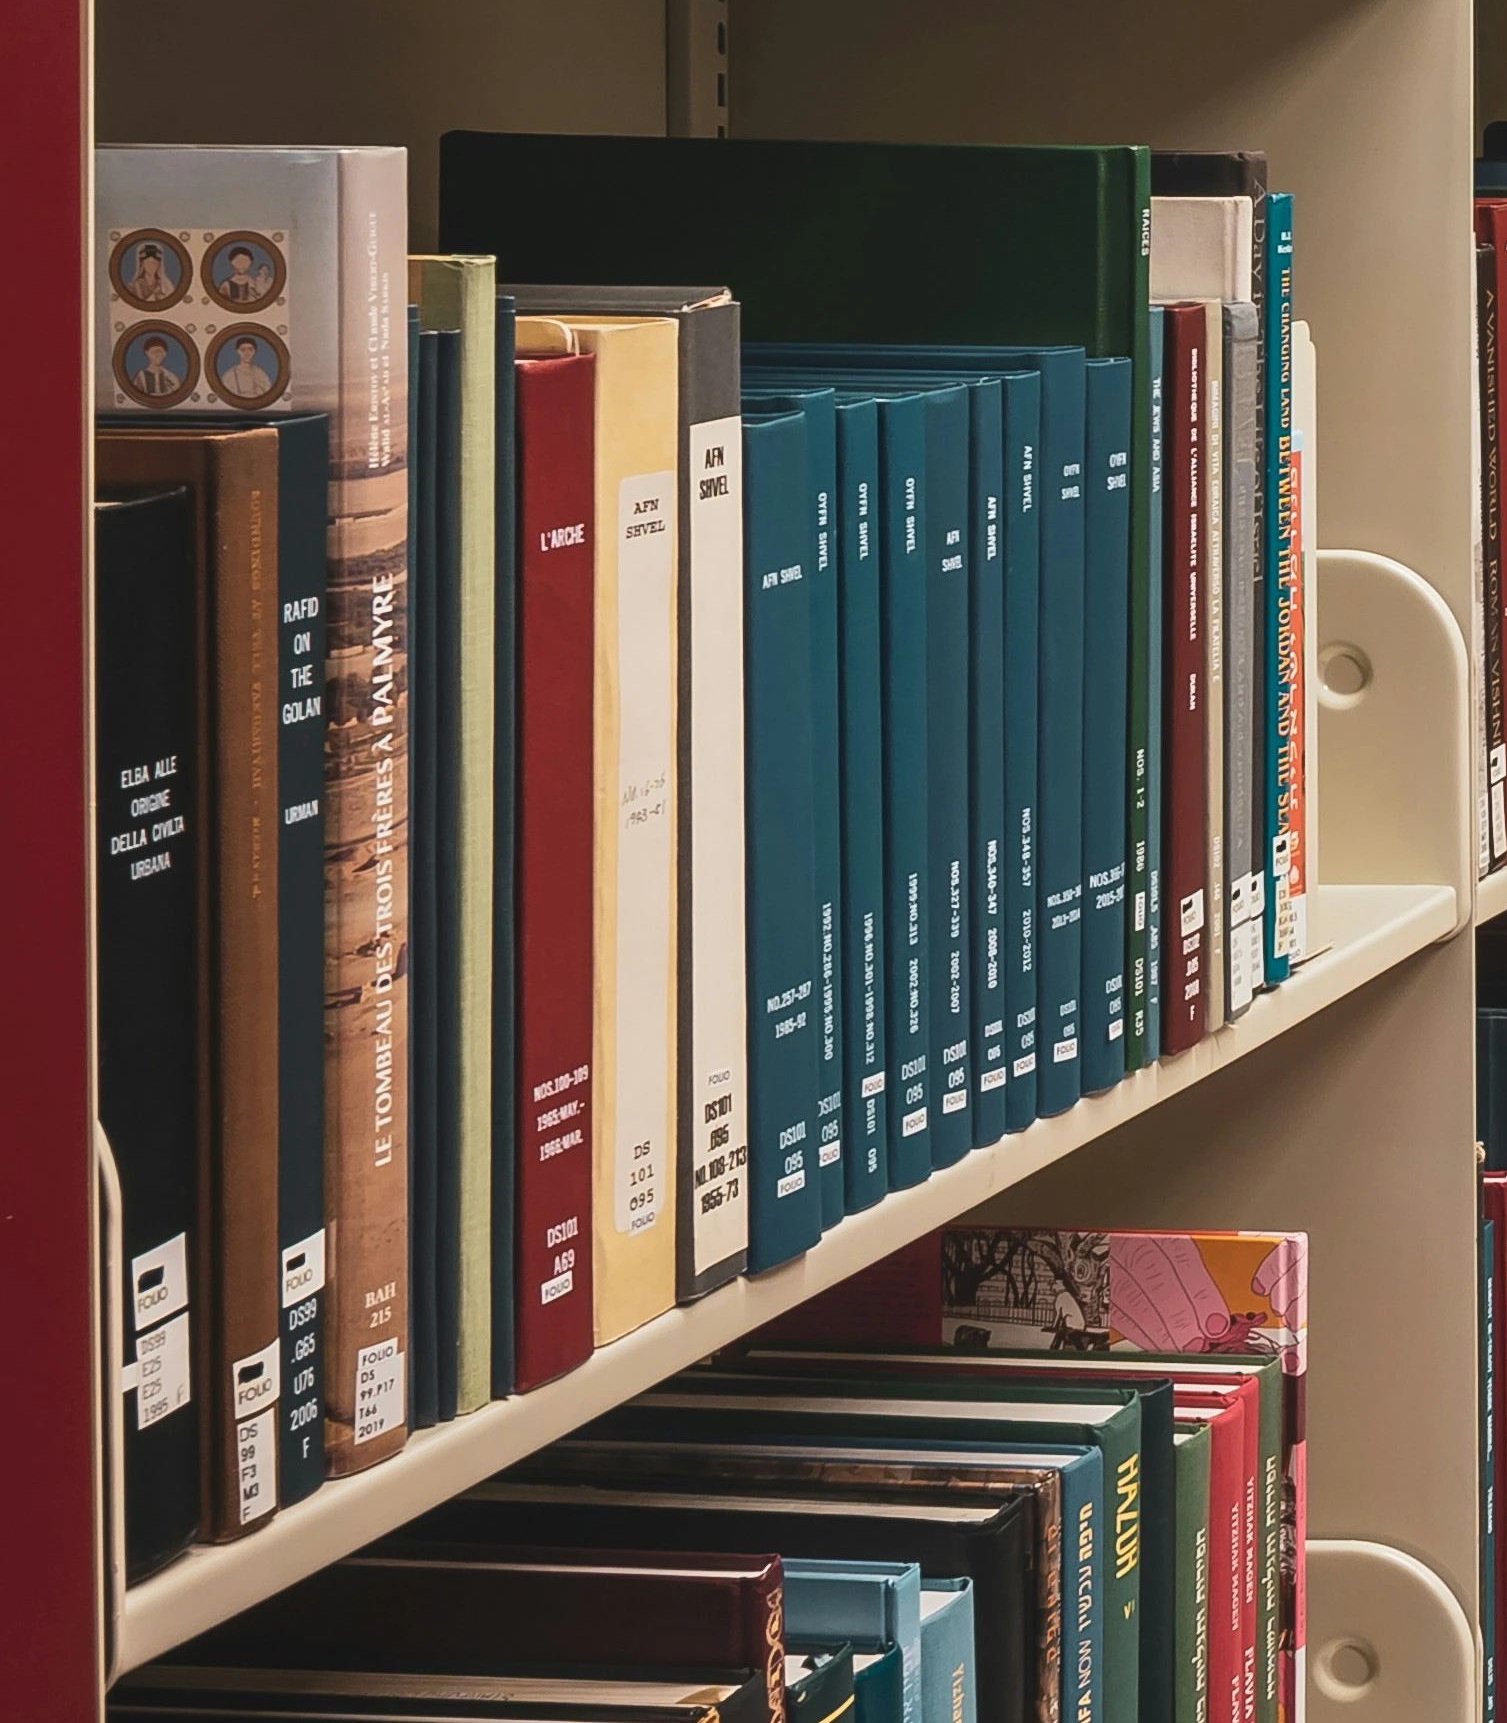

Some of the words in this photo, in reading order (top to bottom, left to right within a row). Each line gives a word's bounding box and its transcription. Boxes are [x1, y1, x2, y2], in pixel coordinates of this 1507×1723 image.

[705, 445, 724, 470] AFN
[1023, 445, 1032, 470] AFN
[700, 475, 729, 500] SHVEL
[1021, 475, 1032, 512] SHVEL
[634, 497, 659, 516] AFN
[540, 523, 585, 552] L'ARCHE
[626, 517, 666, 540] SHVEL
[284, 596, 319, 624] RAFID
[293, 631, 310, 653] ON
[374, 572, 394, 727] PALMYRE
[291, 664, 313, 688] THE
[283, 695, 321, 725] GOLAN
[121, 766, 147, 788] ELBA
[154, 756, 177, 777] ALLE
[132, 789, 170, 817] ORIGINE
[285, 799, 318, 824] URMAN
[371, 757, 392, 854] FRÈRES
[111, 826, 146, 854] DELLA
[131, 852, 171, 880] URBANA
[375, 860, 391, 935] TROIS
[375, 945, 391, 992] DES
[375, 1004, 391, 1128] TOMBEAU
[365, 1282, 397, 1308] BAH
[370, 1306, 391, 1328] 215
[1079, 1501, 1094, 1561] חיפה
[1079, 1565, 1094, 1632] עכשיו
[1080, 1640, 1092, 1689] NOW
